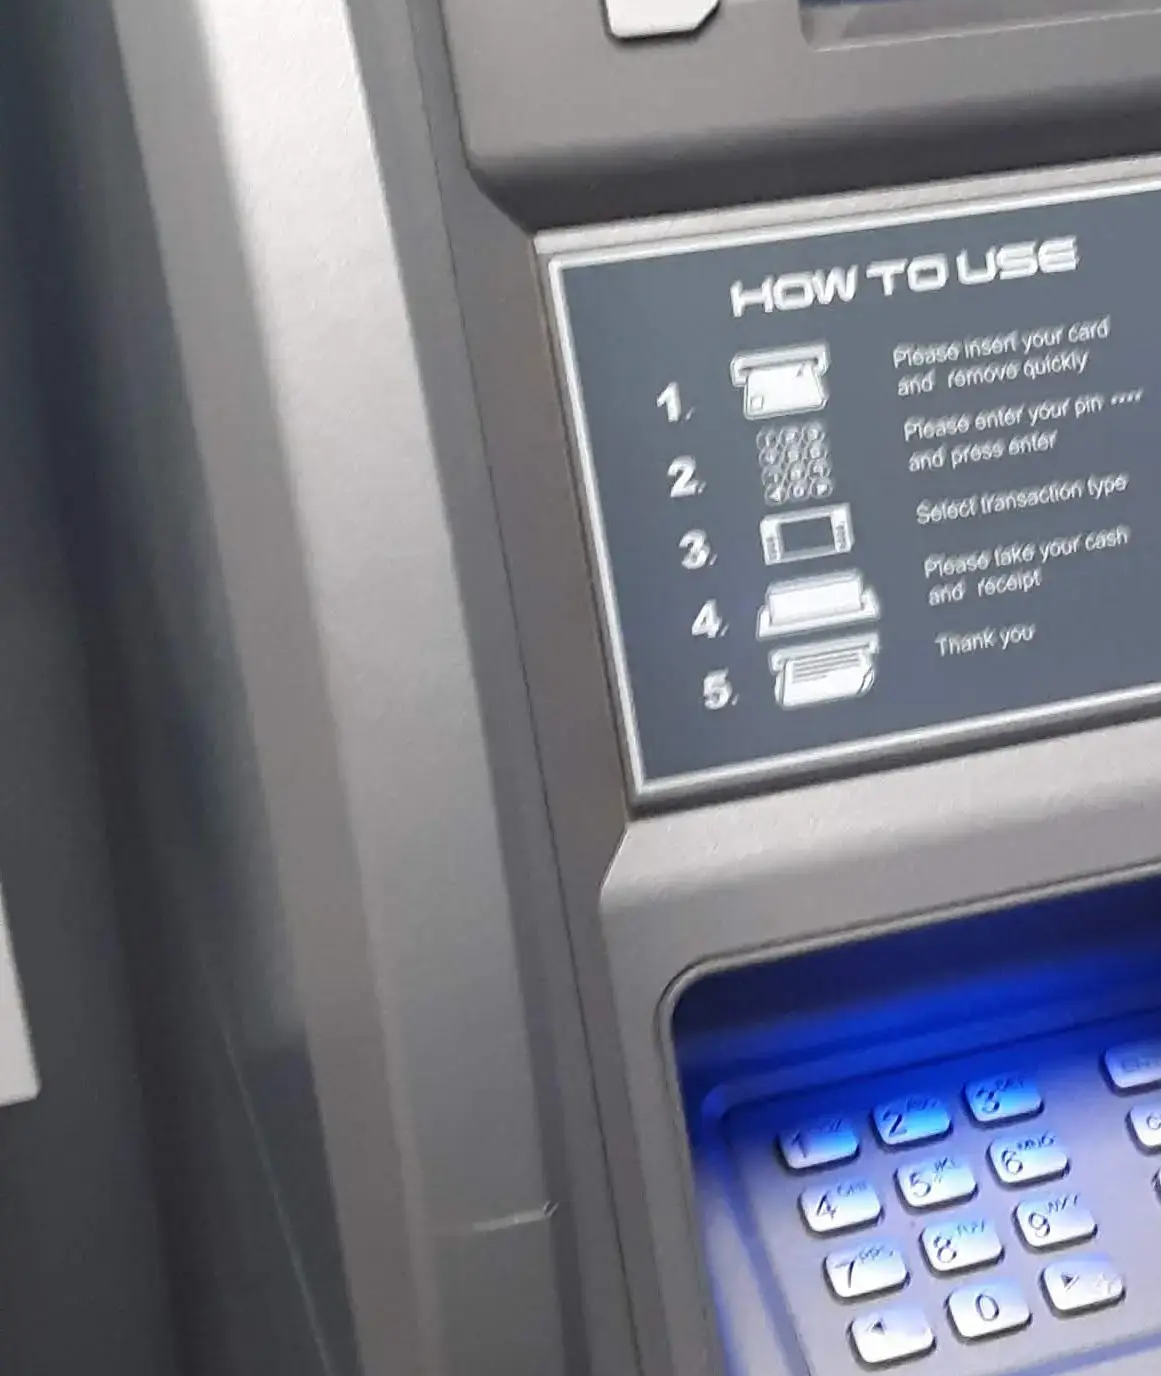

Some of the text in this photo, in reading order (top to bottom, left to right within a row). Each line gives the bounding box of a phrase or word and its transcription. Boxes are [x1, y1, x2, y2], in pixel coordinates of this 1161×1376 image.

[730, 235, 1079, 318] HOW TO USE
[892, 316, 1111, 368] Please insert your card
[897, 350, 1089, 397] and remove quickly
[903, 413, 970, 442] Please
[974, 404, 1025, 431] enter
[1028, 397, 1071, 426] your
[1074, 391, 1104, 419] pin
[908, 429, 1058, 472] and press enter
[916, 472, 1129, 525] Select transaction type
[923, 524, 1131, 578] Please take your cash
[928, 565, 1042, 606] and receipt
[934, 624, 1036, 657] Thank you
[976, 1087, 999, 1112] 3
[883, 1111, 907, 1137] 2
[1001, 1150, 1023, 1174] 6
[909, 1172, 931, 1197] 5
[817, 1194, 836, 1219] 4
[1028, 1212, 1050, 1238] 9
[933, 1236, 957, 1262] 8
[834, 1258, 857, 1288] 7
[975, 1290, 999, 1321] 0
